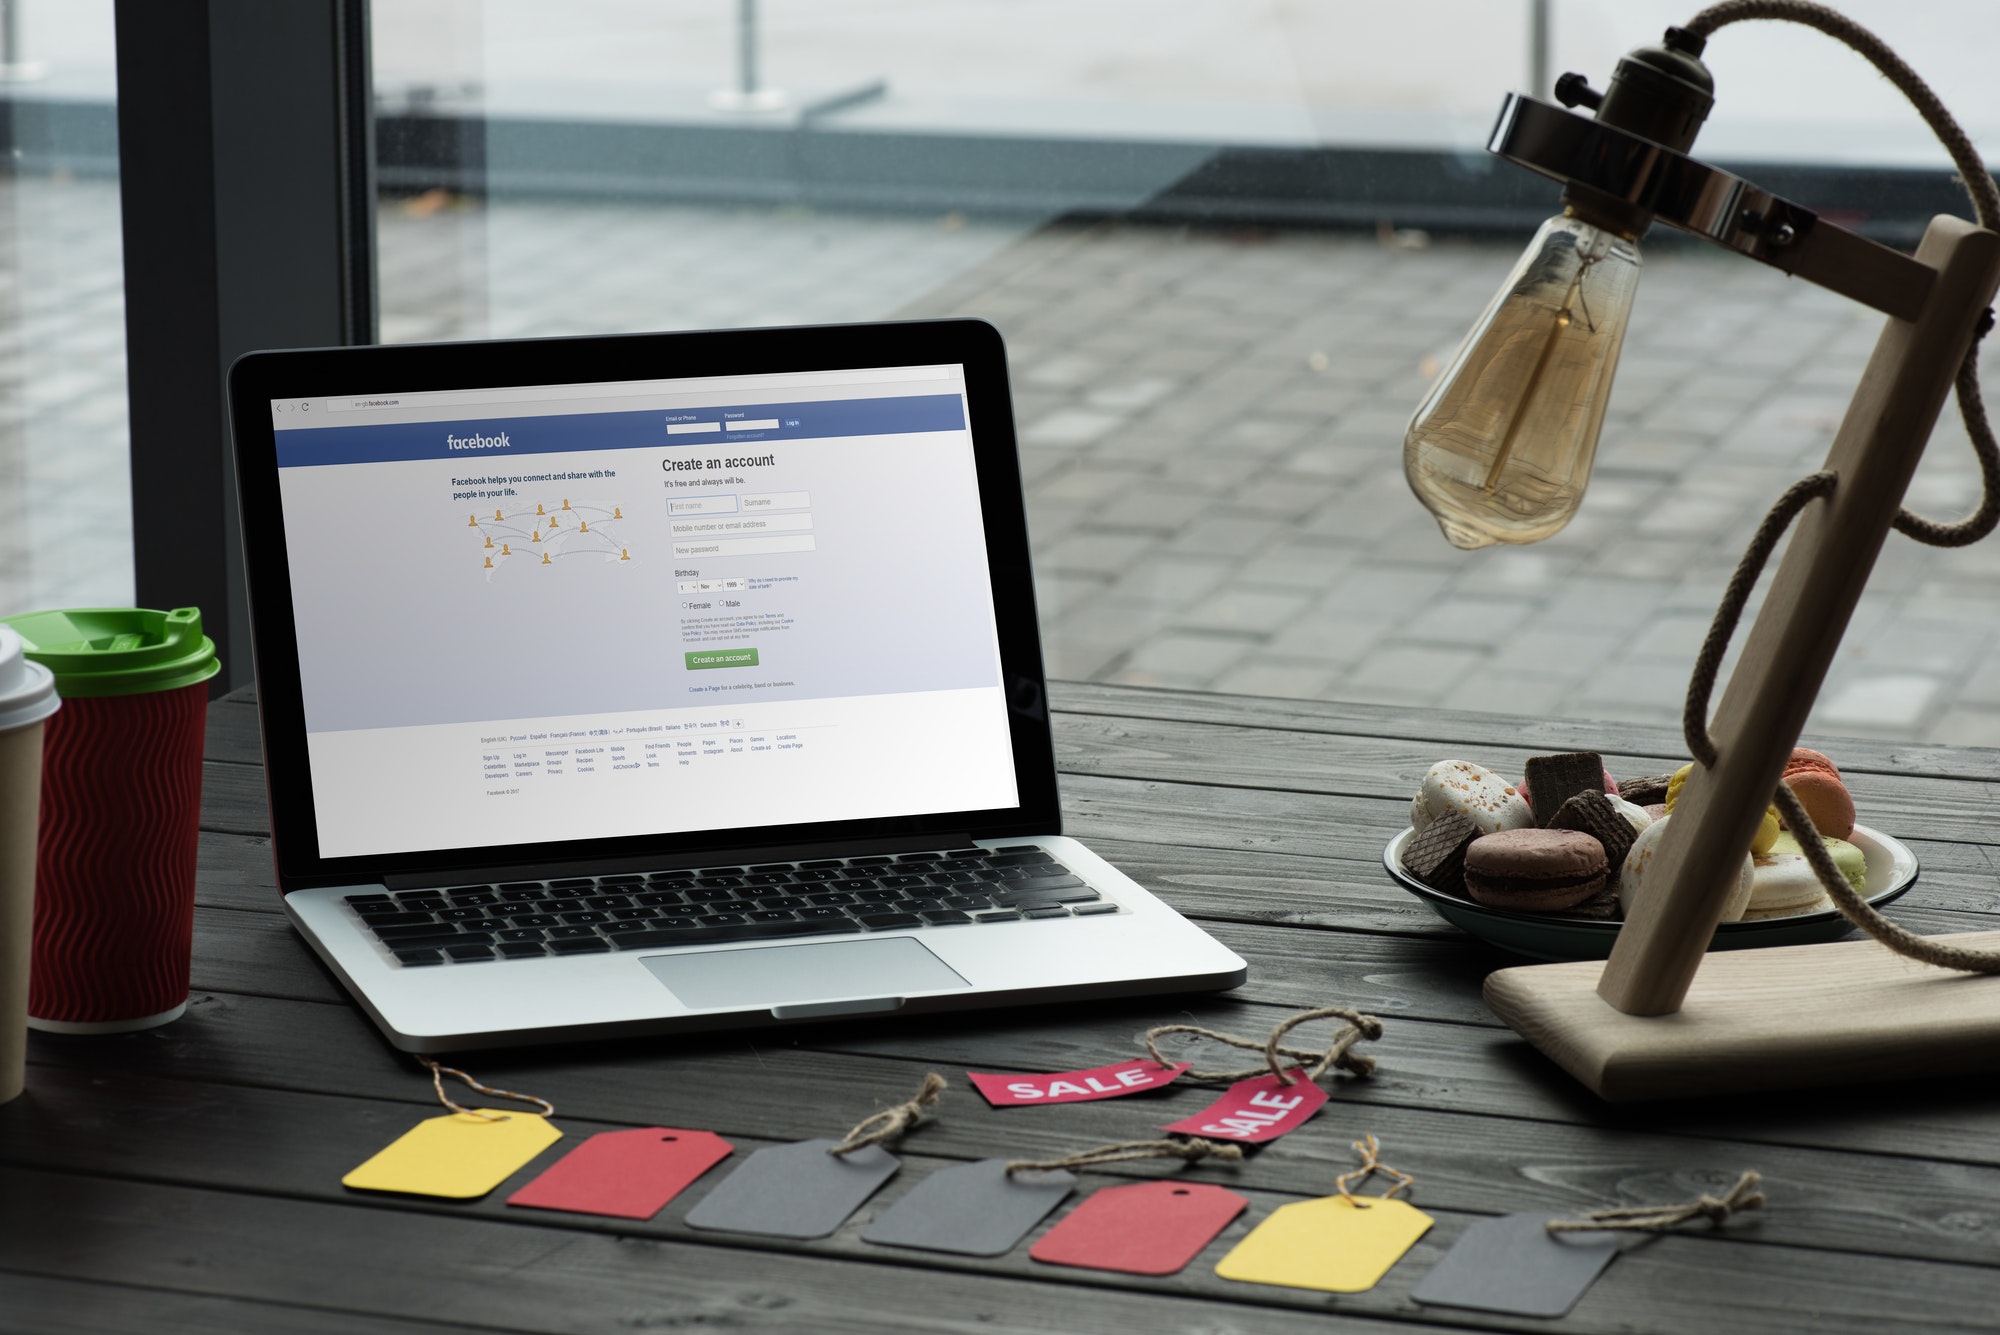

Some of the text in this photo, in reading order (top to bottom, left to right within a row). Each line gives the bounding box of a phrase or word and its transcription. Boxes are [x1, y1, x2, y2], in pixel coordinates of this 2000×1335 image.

[447, 432, 510, 450] facebook
[662, 454, 775, 472] Create an account
[452, 478, 487, 486] Facebook
[488, 476, 507, 485] helps
[508, 476, 522, 485] you
[523, 474, 552, 482] connect
[553, 472, 566, 480] and
[567, 472, 587, 480] share
[588, 470, 603, 478] with
[701, 478, 723, 486] always
[453, 488, 517, 500] people in your life.
[744, 499, 771, 507] Surname
[694, 523, 716, 531] number
[691, 545, 719, 554] password
[674, 569, 700, 577] Birthday
[689, 602, 711, 610] Female
[725, 654, 751, 662] account
[1007, 1068, 1154, 1099] SALE
[1201, 1091, 1303, 1138] SALE
